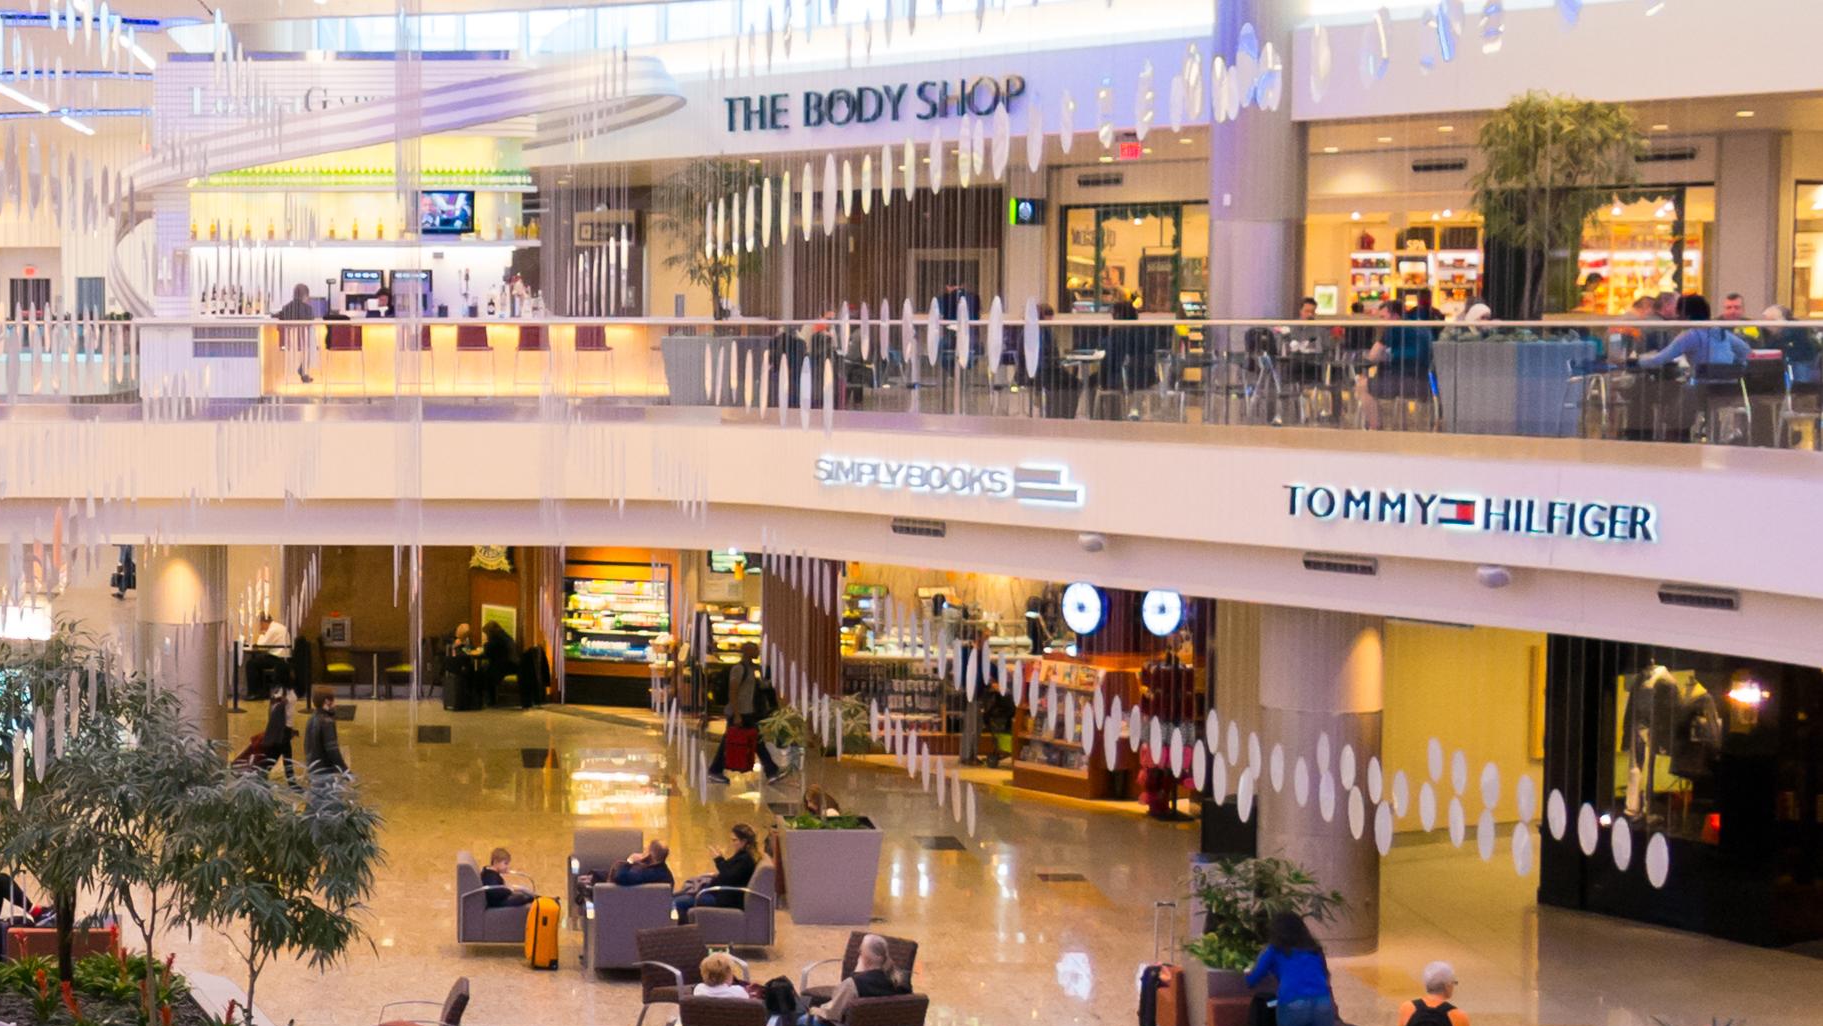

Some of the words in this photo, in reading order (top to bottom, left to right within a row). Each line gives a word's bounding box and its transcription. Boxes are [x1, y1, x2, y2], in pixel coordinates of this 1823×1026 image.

[724, 93, 789, 132] THE
[803, 83, 908, 127] BODY
[916, 74, 1026, 121] SHOP
[1283, 485, 1438, 525] TOMMY
[1483, 498, 1653, 541] HILFIGER
